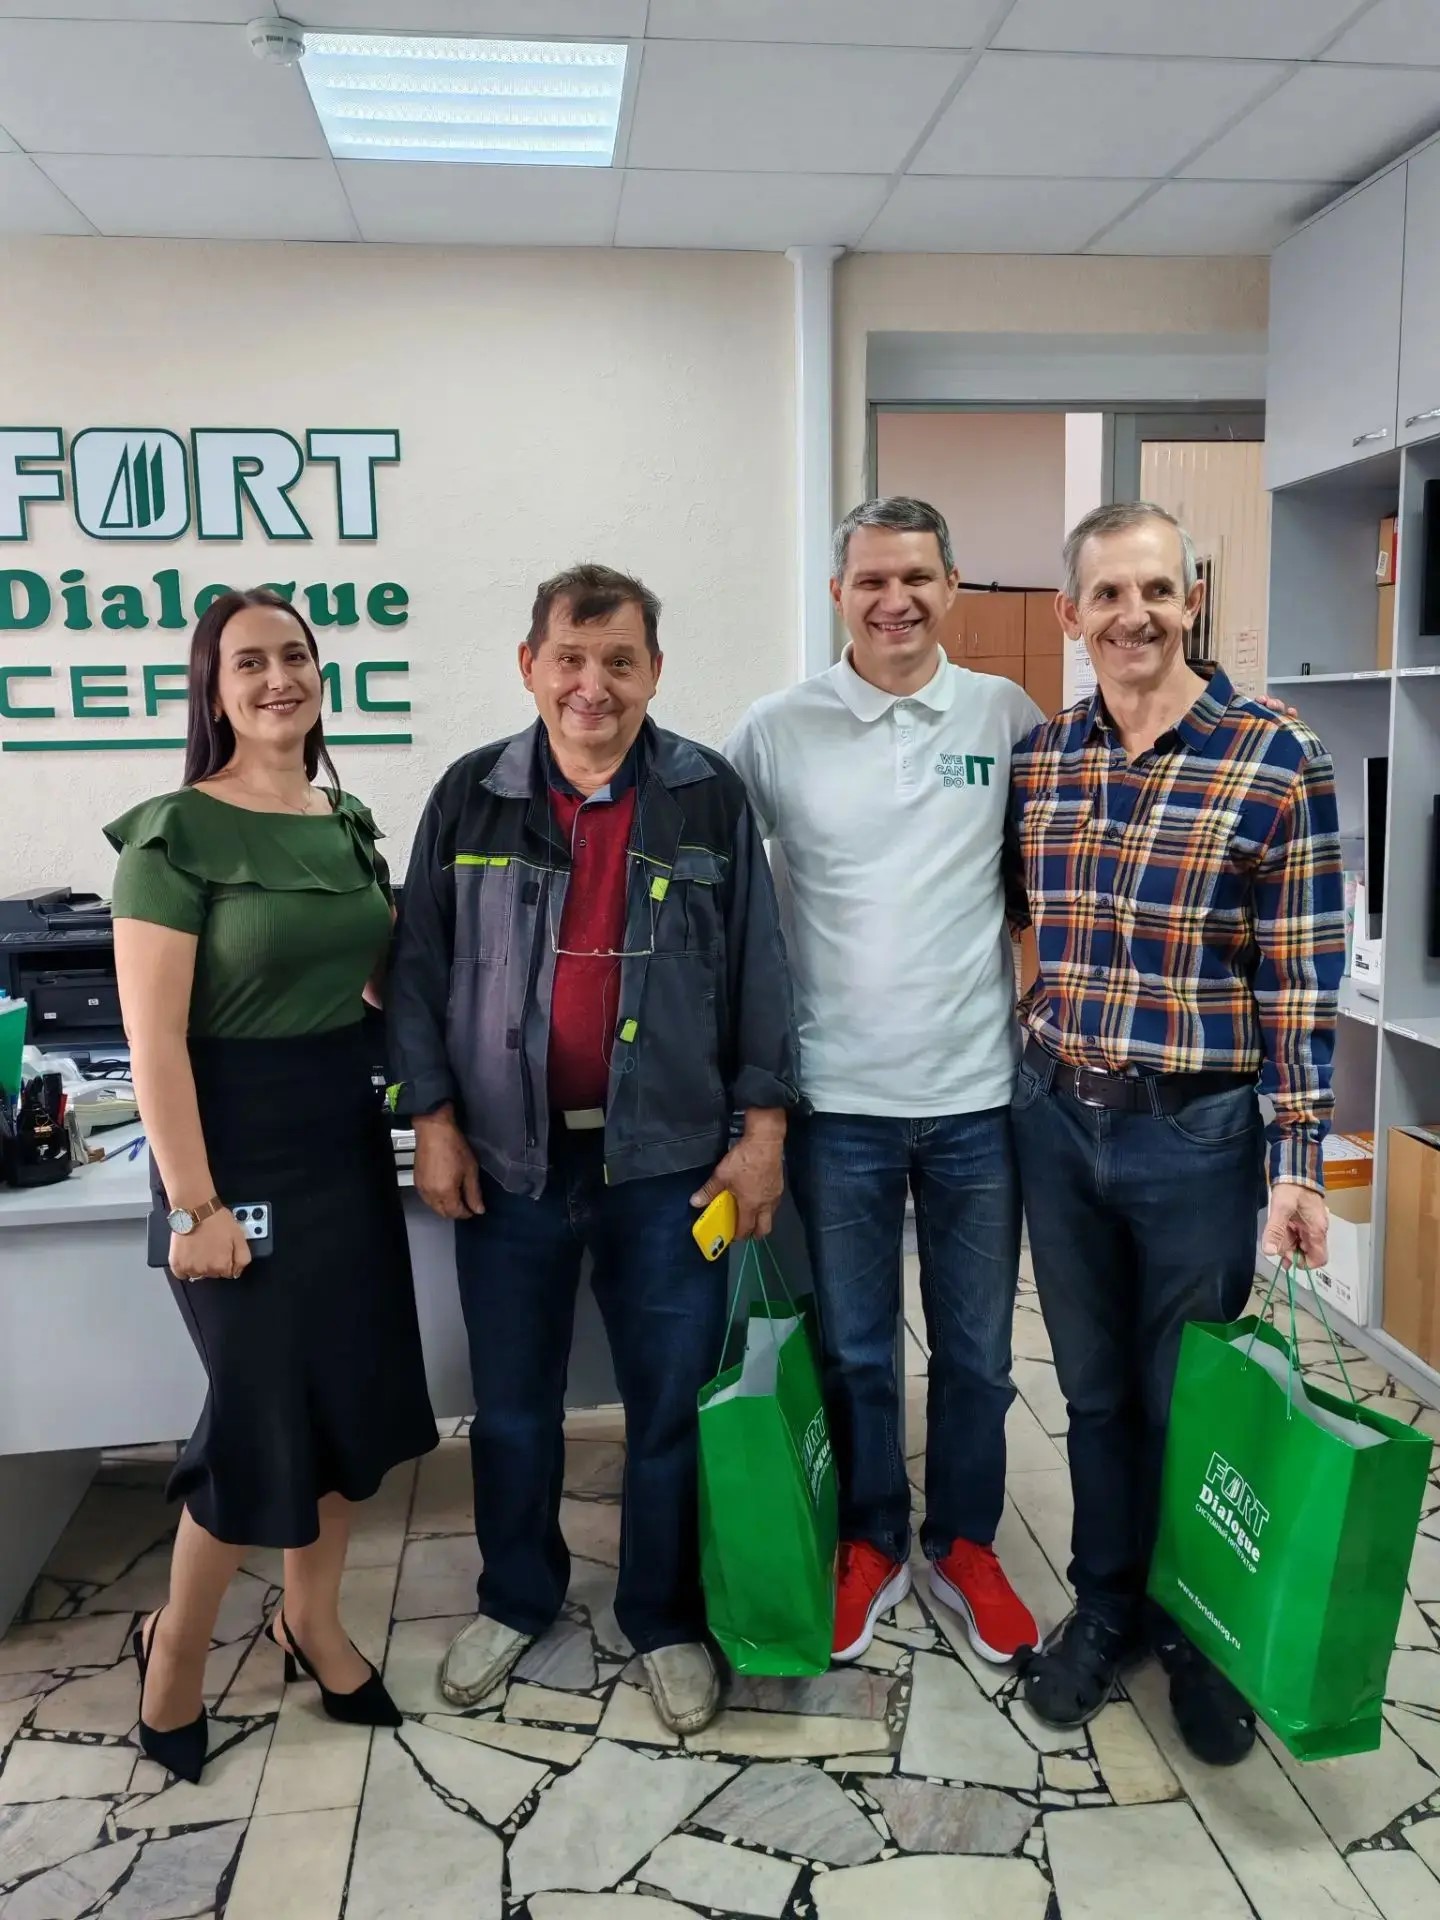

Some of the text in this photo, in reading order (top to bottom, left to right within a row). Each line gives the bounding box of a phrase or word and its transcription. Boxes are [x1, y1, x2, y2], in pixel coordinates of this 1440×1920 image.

[0, 427, 401, 541] FORT
[0, 568, 410, 631] Dialue
[935, 764, 964, 776] CAN
[940, 753, 963, 764] WE
[944, 776, 964, 788] DO
[965, 755, 995, 786] IT
[1205, 1451, 1270, 1538] FORT
[1199, 1483, 1260, 1562] Dialogue
